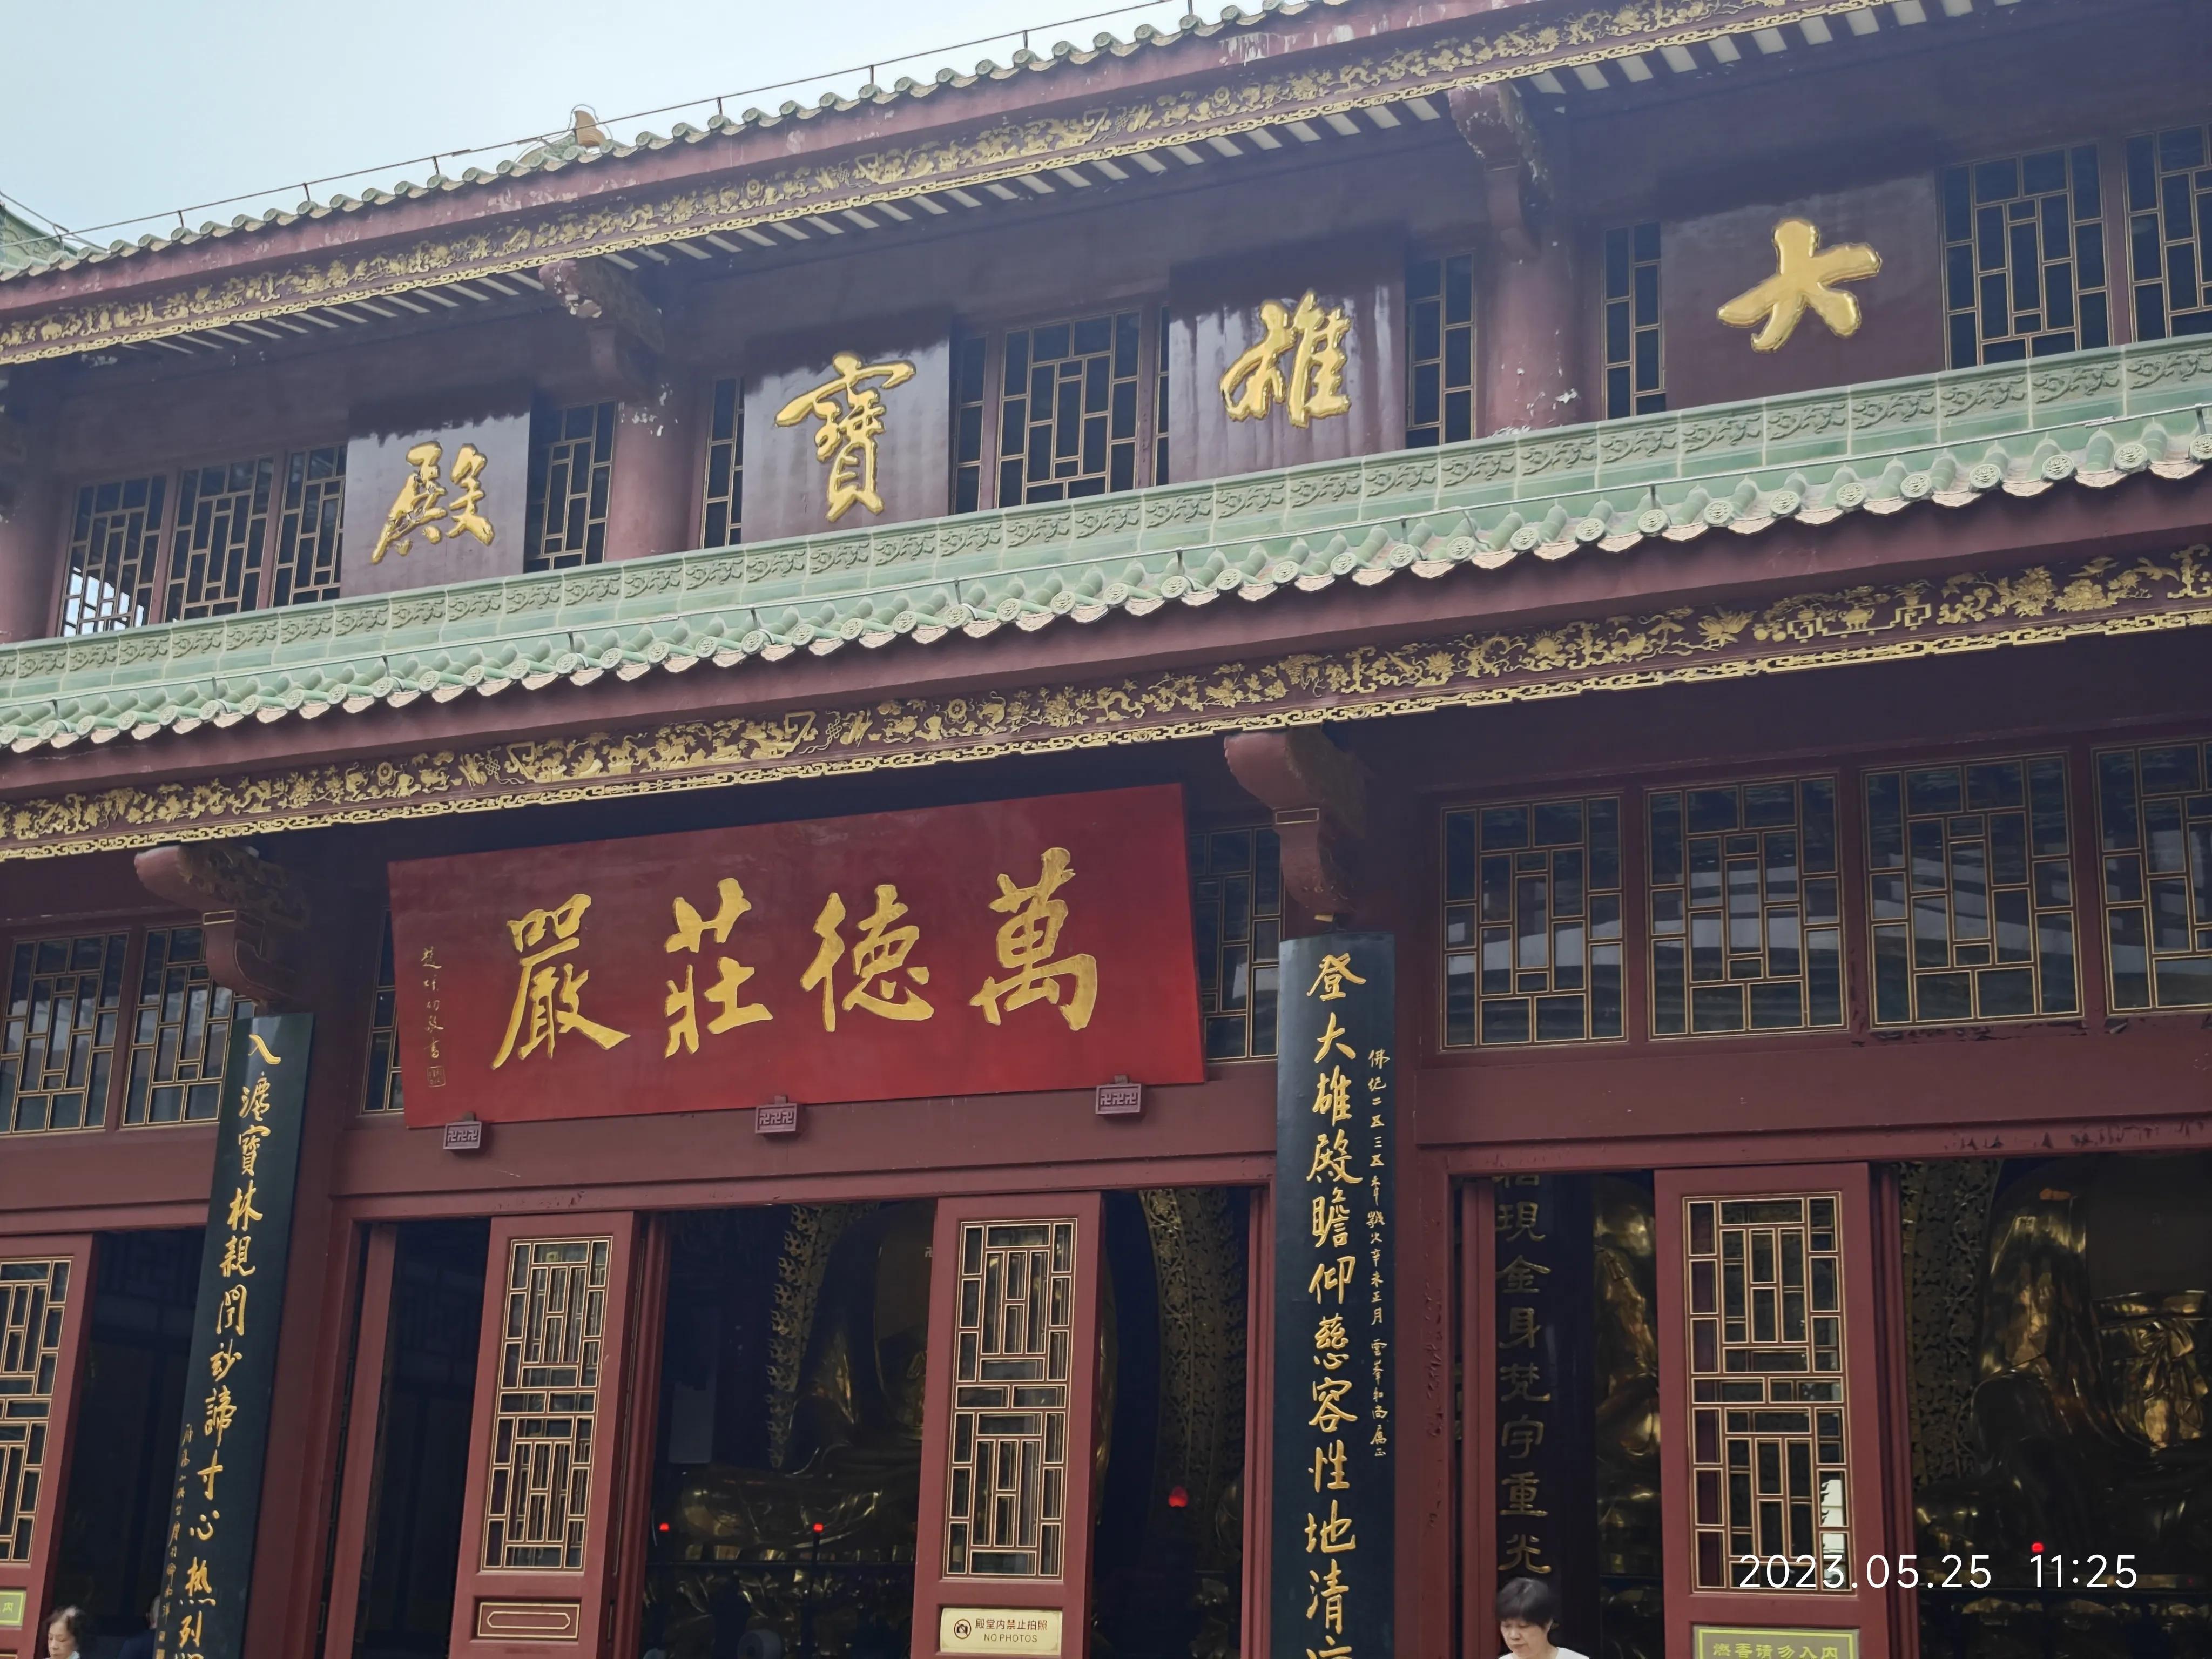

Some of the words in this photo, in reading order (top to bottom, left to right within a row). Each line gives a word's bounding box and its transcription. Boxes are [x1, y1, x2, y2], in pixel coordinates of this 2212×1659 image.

[975, 1618, 1048, 1631] 殿堂内禁止拍照
[984, 1633, 997, 1642] NO
[999, 1634, 1038, 1643] PHOTOS
